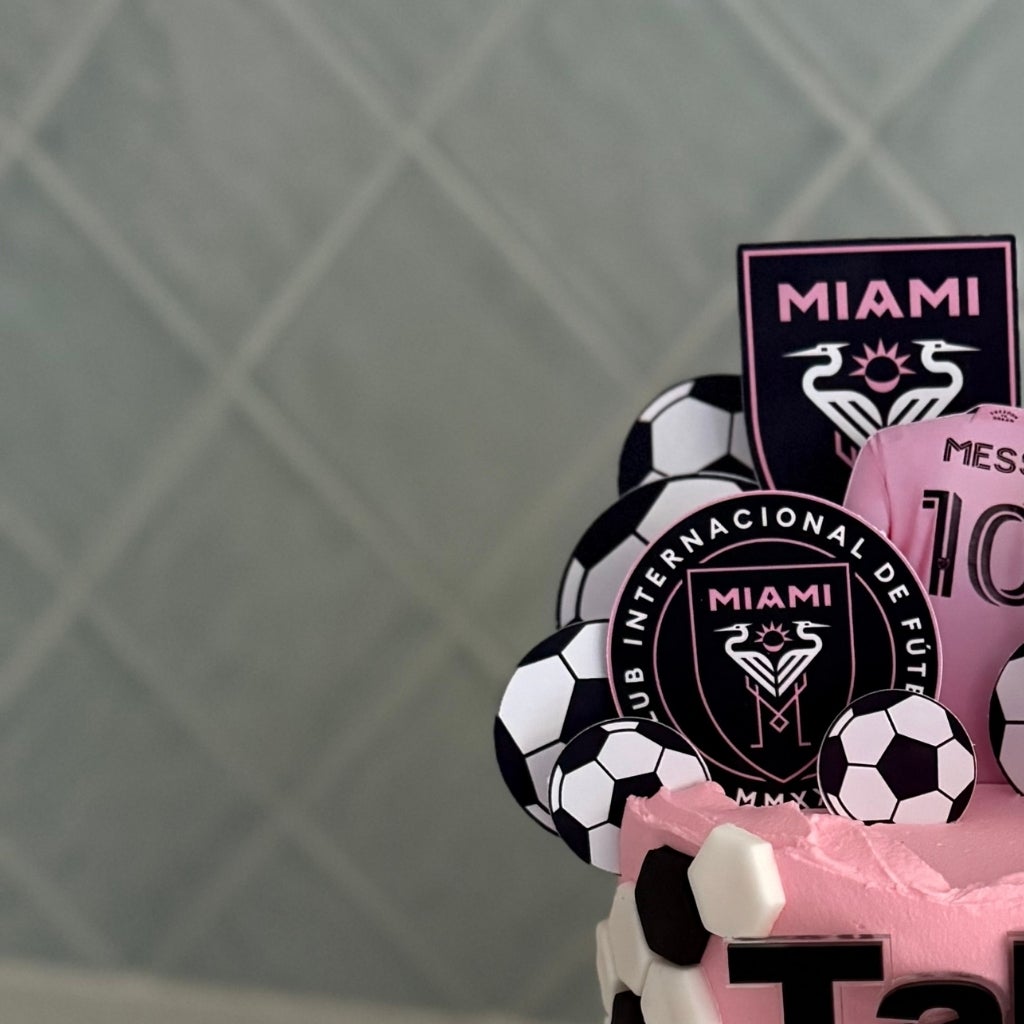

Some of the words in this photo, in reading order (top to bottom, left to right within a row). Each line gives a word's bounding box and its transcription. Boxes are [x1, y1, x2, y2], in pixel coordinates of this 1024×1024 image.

[777, 276, 981, 323] MIAMI
[622, 506, 865, 647] INTERNACIONAL
[873, 562, 910, 604] DE
[708, 583, 832, 612] MIAMI
